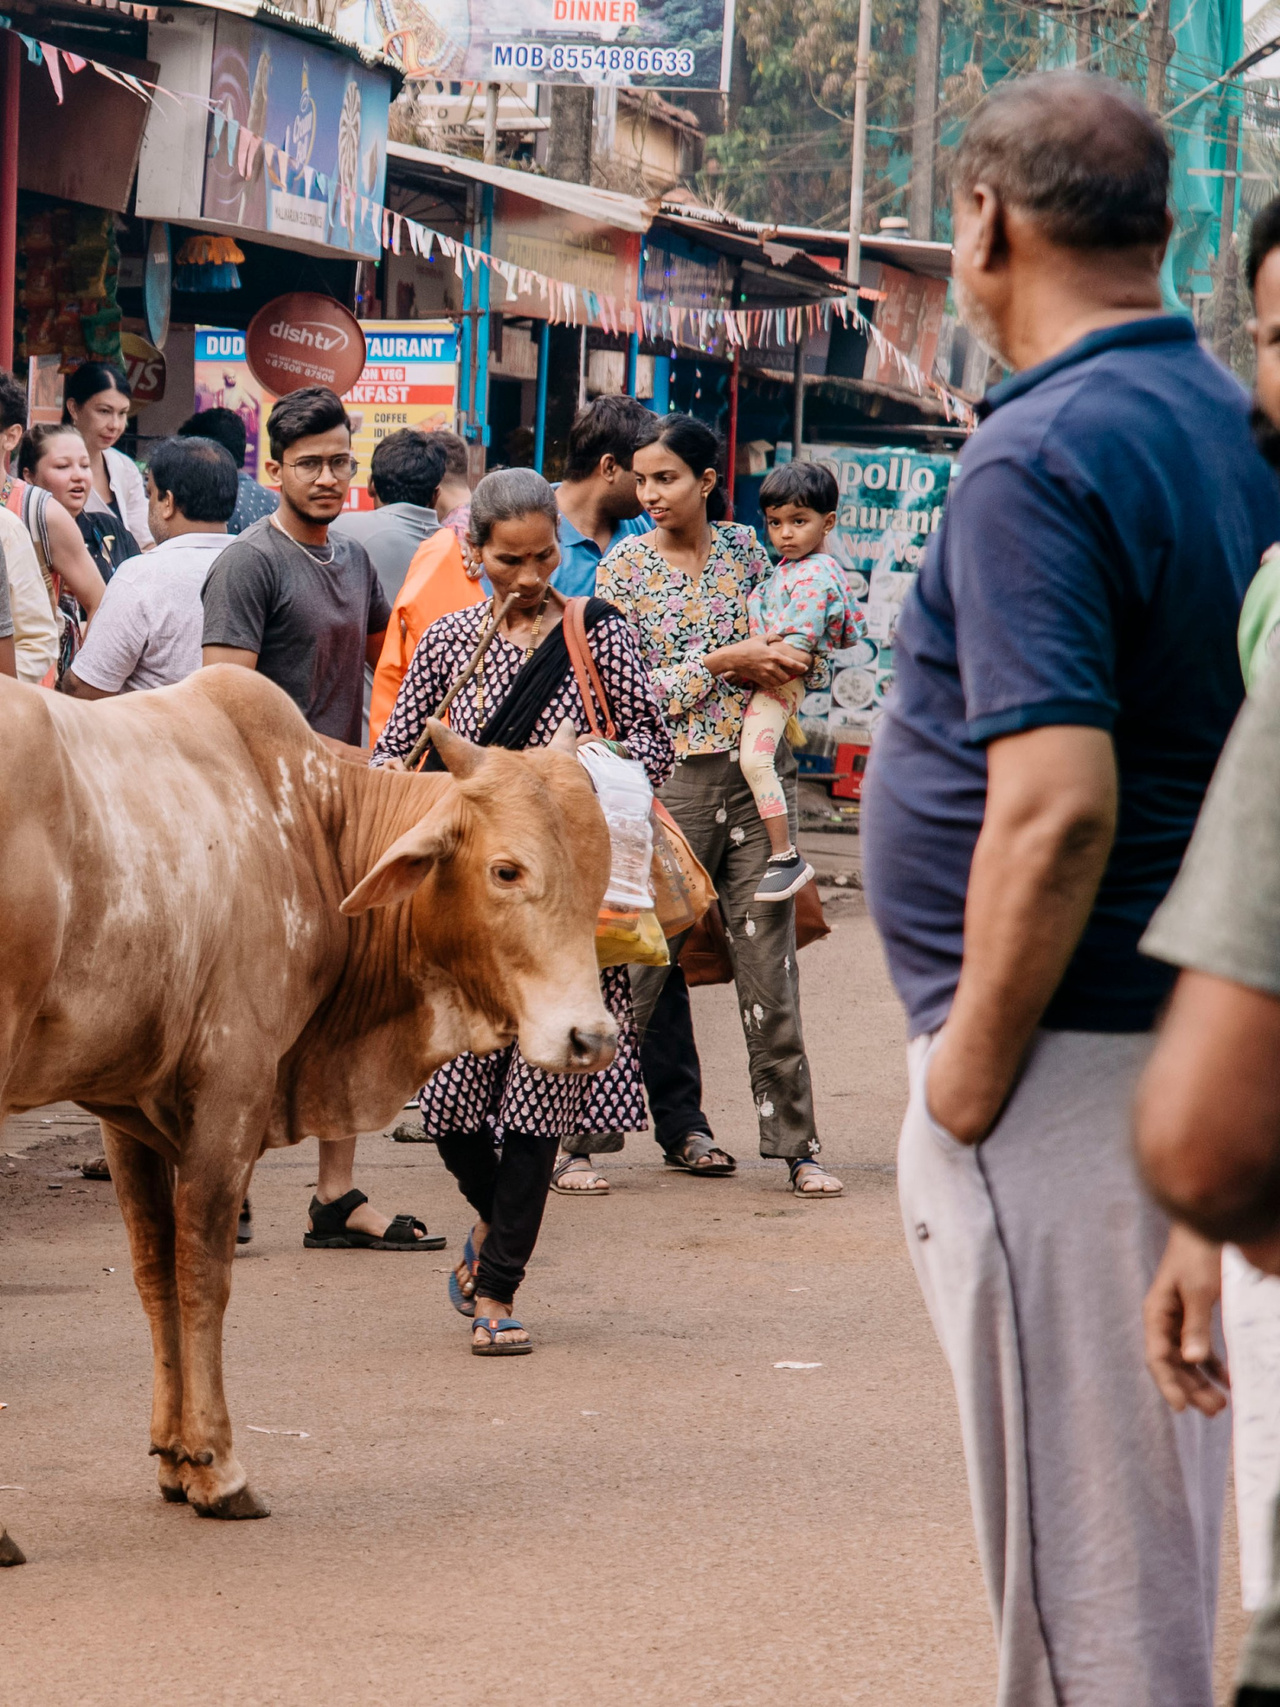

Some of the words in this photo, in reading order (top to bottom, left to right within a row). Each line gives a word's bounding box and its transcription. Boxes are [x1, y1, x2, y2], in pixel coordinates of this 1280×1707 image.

[554, 0, 637, 23] DINNER
[493, 45, 543, 67] MOB
[552, 47, 693, 73] 8554886633
[206, 336, 246, 356] DUD
[365, 337, 445, 358] TAURANT
[269, 321, 345, 352] dishtv
[271, 359, 302, 374] 87506
[304, 367, 335, 383] 87506
[359, 368, 379, 381] ON
[380, 368, 404, 381] VEG
[340, 385, 411, 403] AKFAST
[374, 412, 408, 424] COFFEE
[838, 503, 944, 535] aurant
